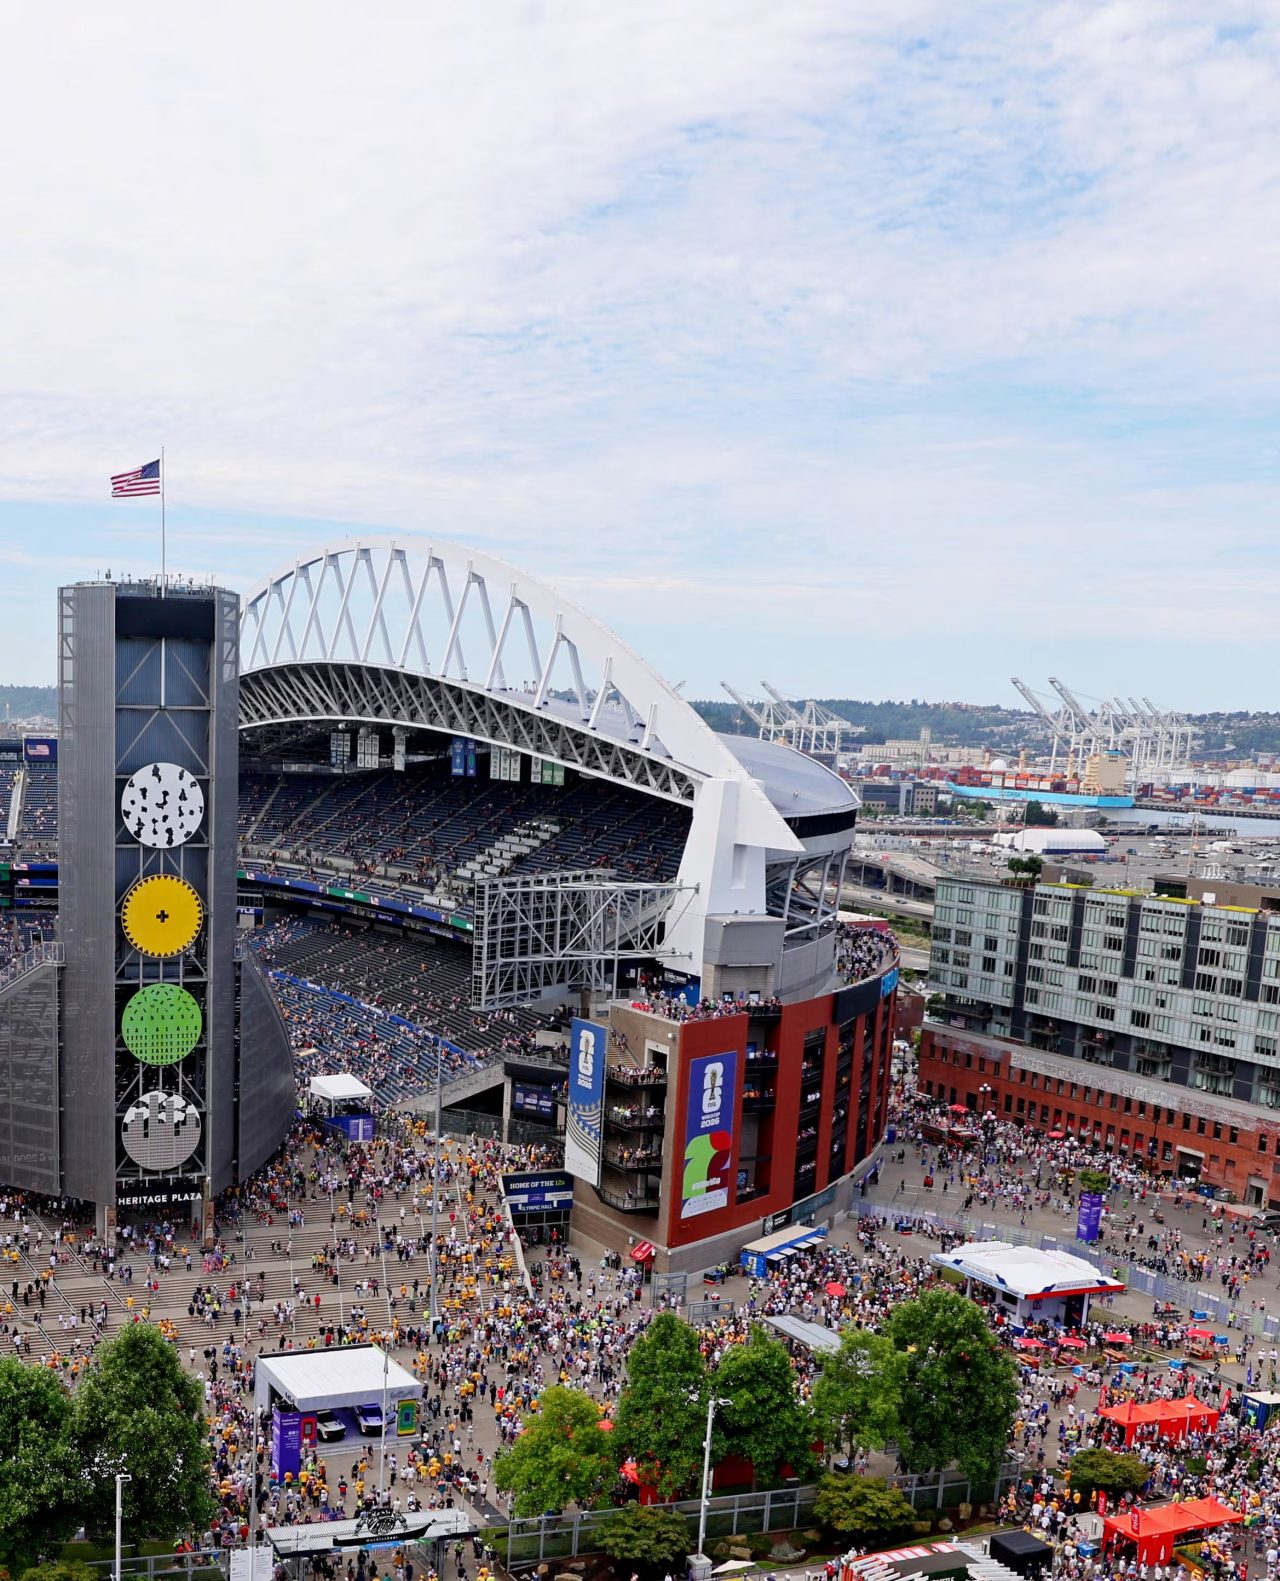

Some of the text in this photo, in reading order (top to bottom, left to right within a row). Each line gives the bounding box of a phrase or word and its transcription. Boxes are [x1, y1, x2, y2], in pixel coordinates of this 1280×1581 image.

[700, 1118, 720, 1128] 2026
[510, 1182, 530, 1190] HOME
[118, 1192, 203, 1206] HERITAGE PLAZA
